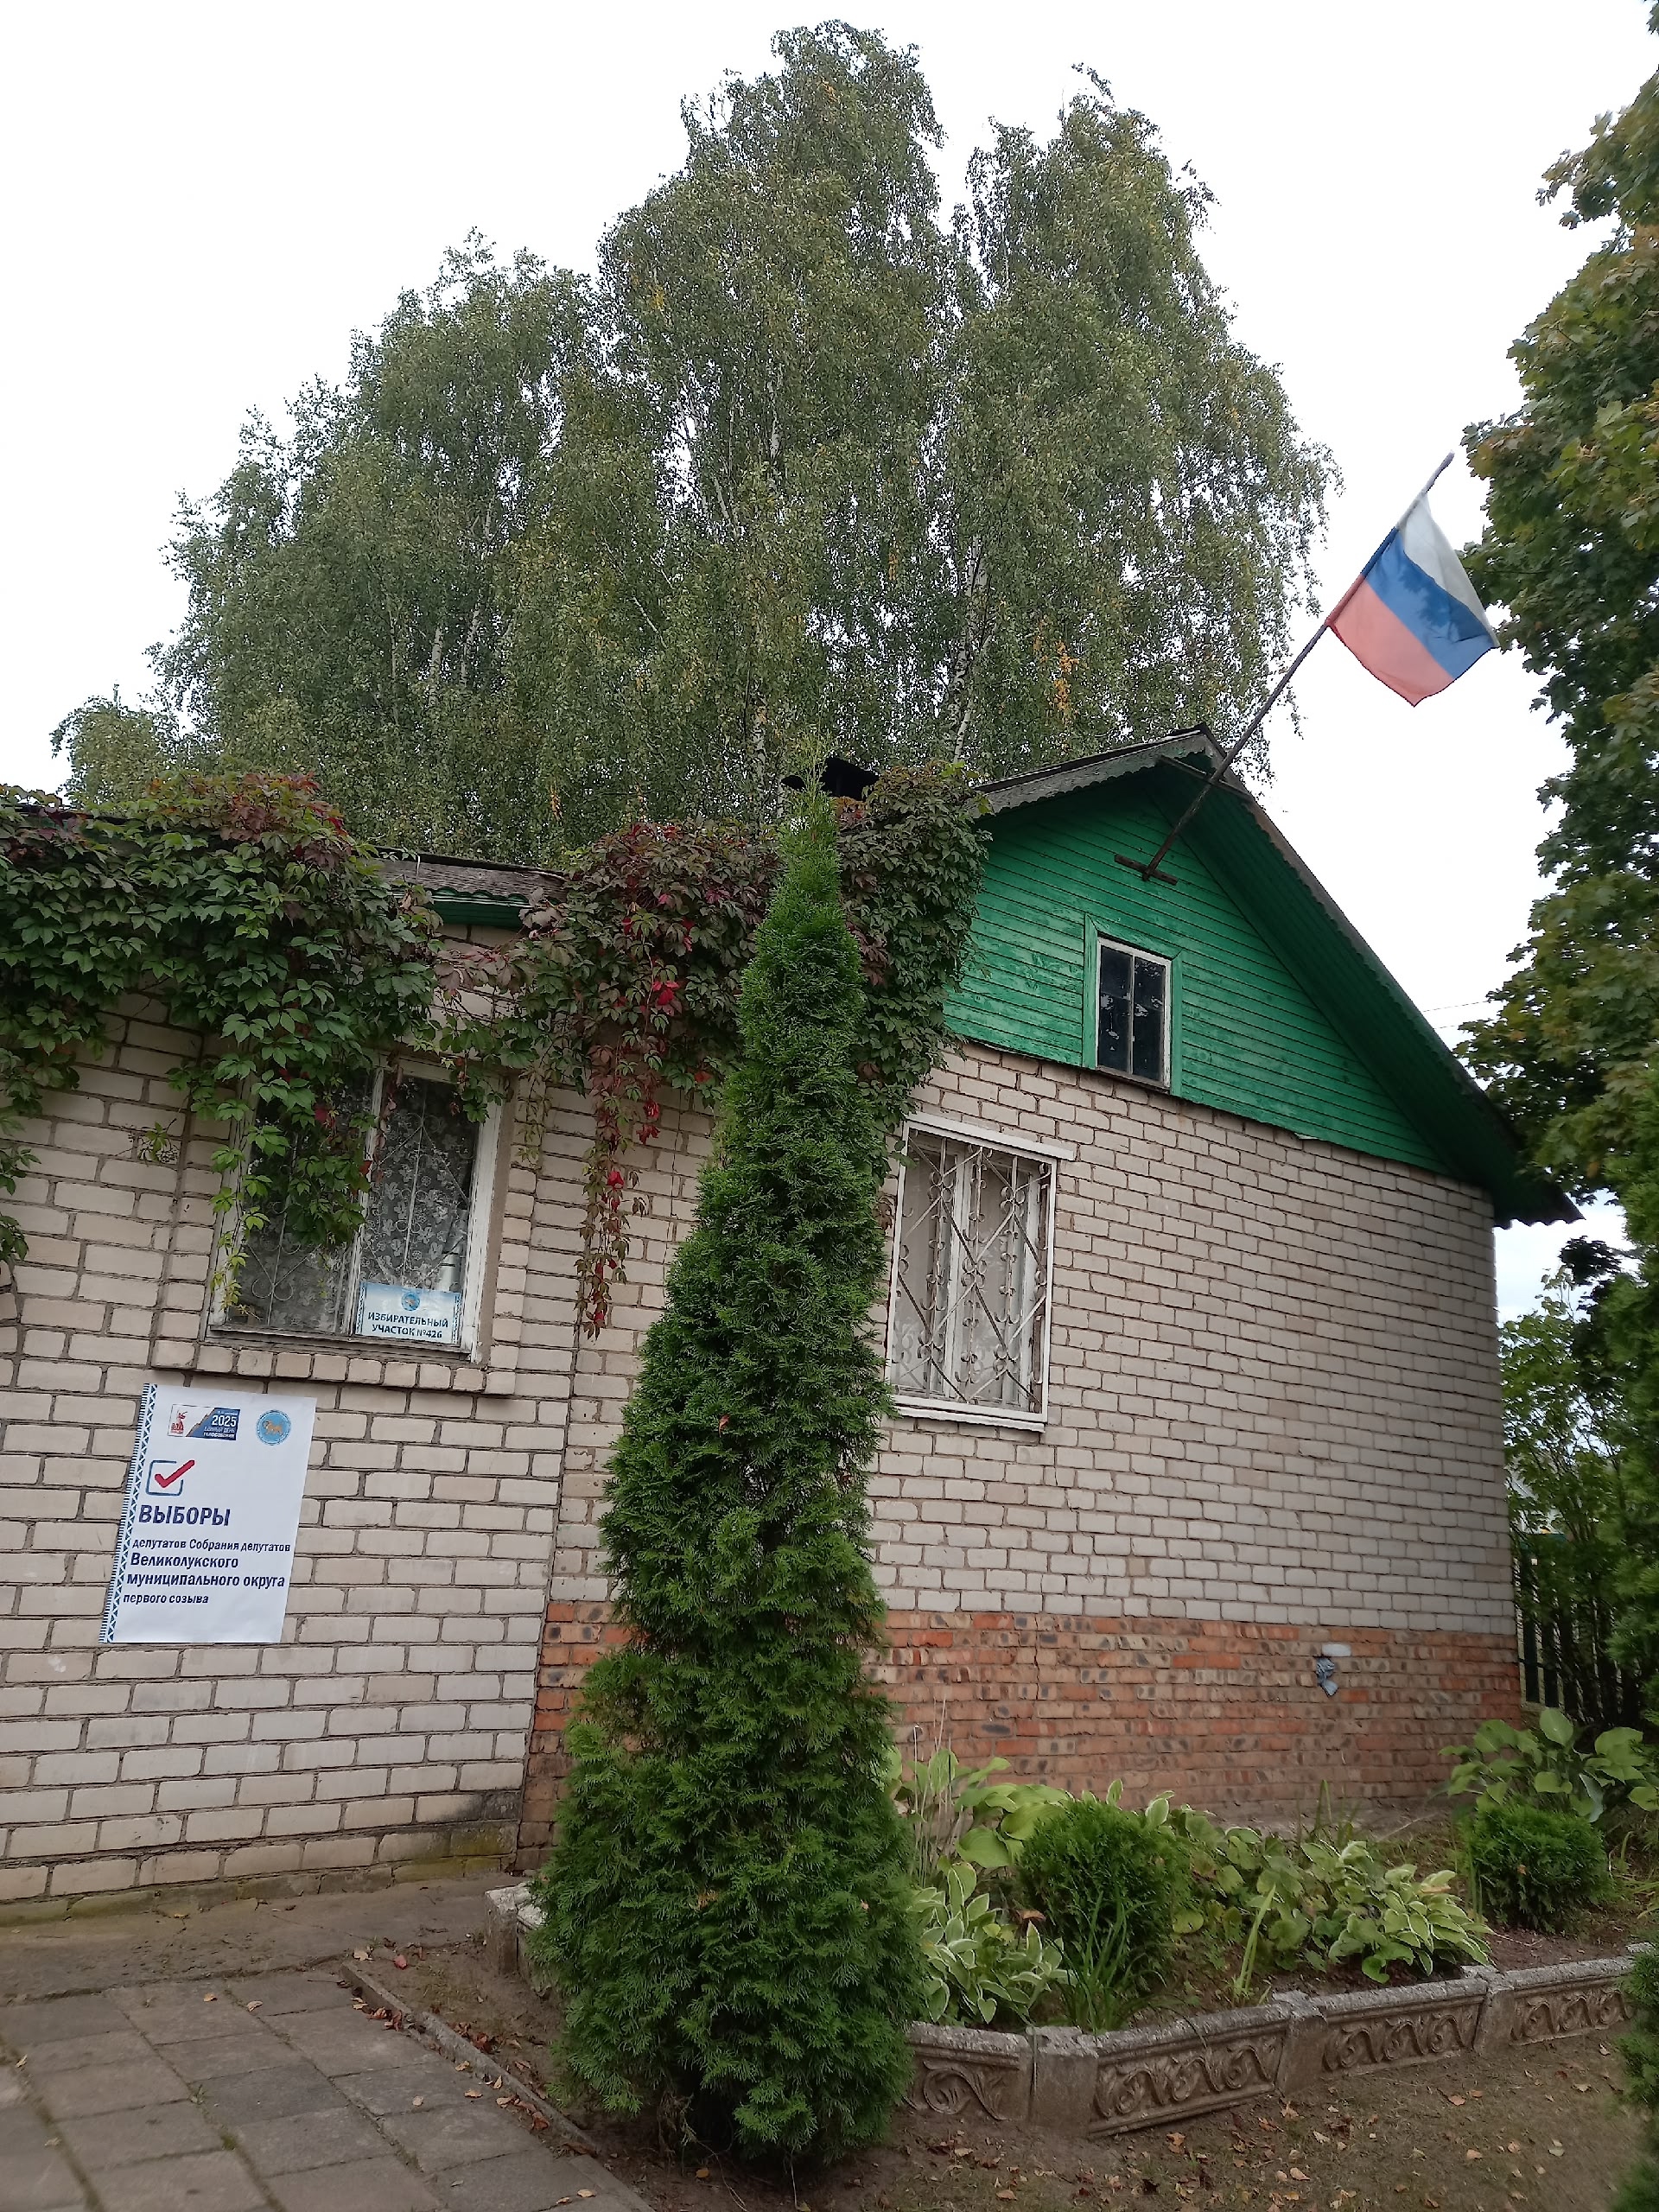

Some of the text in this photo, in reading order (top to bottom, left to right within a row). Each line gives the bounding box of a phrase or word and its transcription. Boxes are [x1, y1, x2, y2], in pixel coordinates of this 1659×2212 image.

[368, 1313, 448, 1327] ИЗБИРАТЕЛЬНЫЙ
[372, 1324, 415, 1336] УЧАСТОК
[212, 1414, 237, 1427] 2025
[138, 1504, 231, 1527] ВЫБОРЫ
[132, 1539, 290, 1554] депутатов Собрания депутатов
[130, 1553, 238, 1570] Великолукского
[243, 1577, 285, 1590] округа
[123, 1593, 209, 1605] первого созыва
